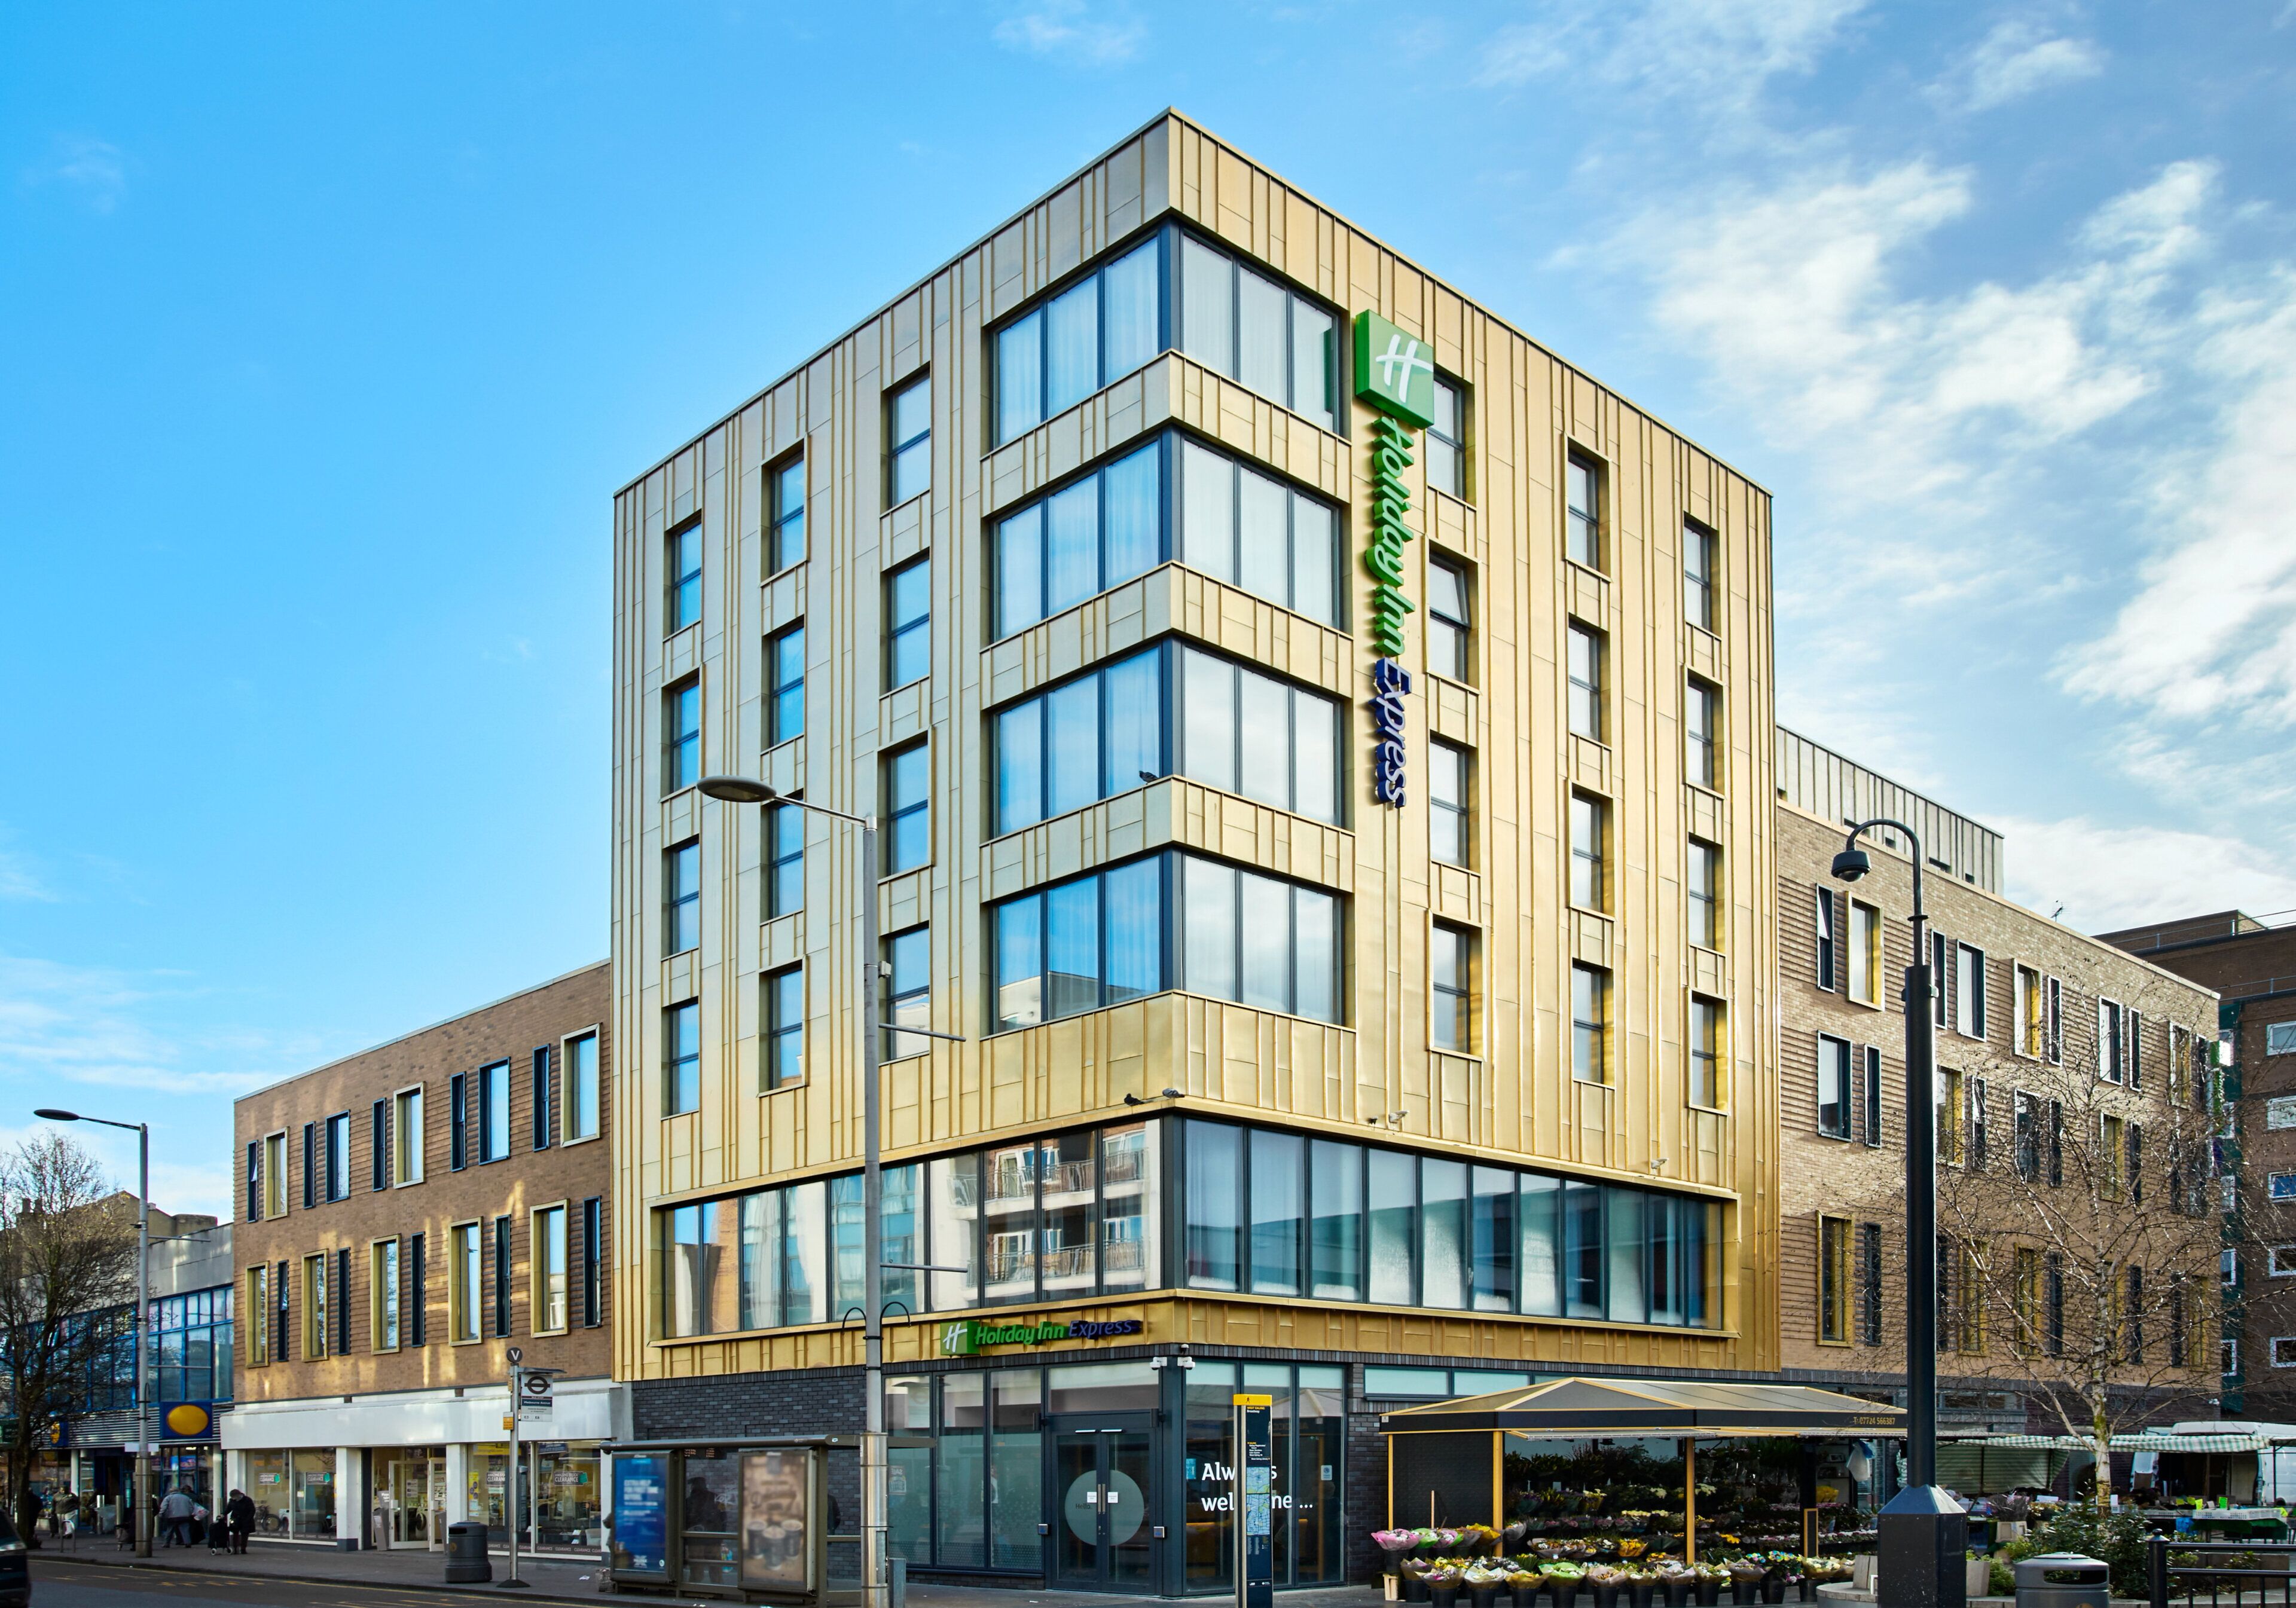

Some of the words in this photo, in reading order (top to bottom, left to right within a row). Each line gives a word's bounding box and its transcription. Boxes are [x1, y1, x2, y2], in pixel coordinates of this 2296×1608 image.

[1370, 416, 1415, 586] Holiday
[1377, 583, 1416, 657] Inn
[1373, 657, 1412, 808] Express
[975, 1323, 1036, 1345] Holiday
[1037, 1320, 1065, 1340] Inn
[1068, 1320, 1132, 1340] Express
[510, 1350, 520, 1361] V
[1201, 1461, 1278, 1481] Alws
[1201, 1491, 1293, 1512] welme
